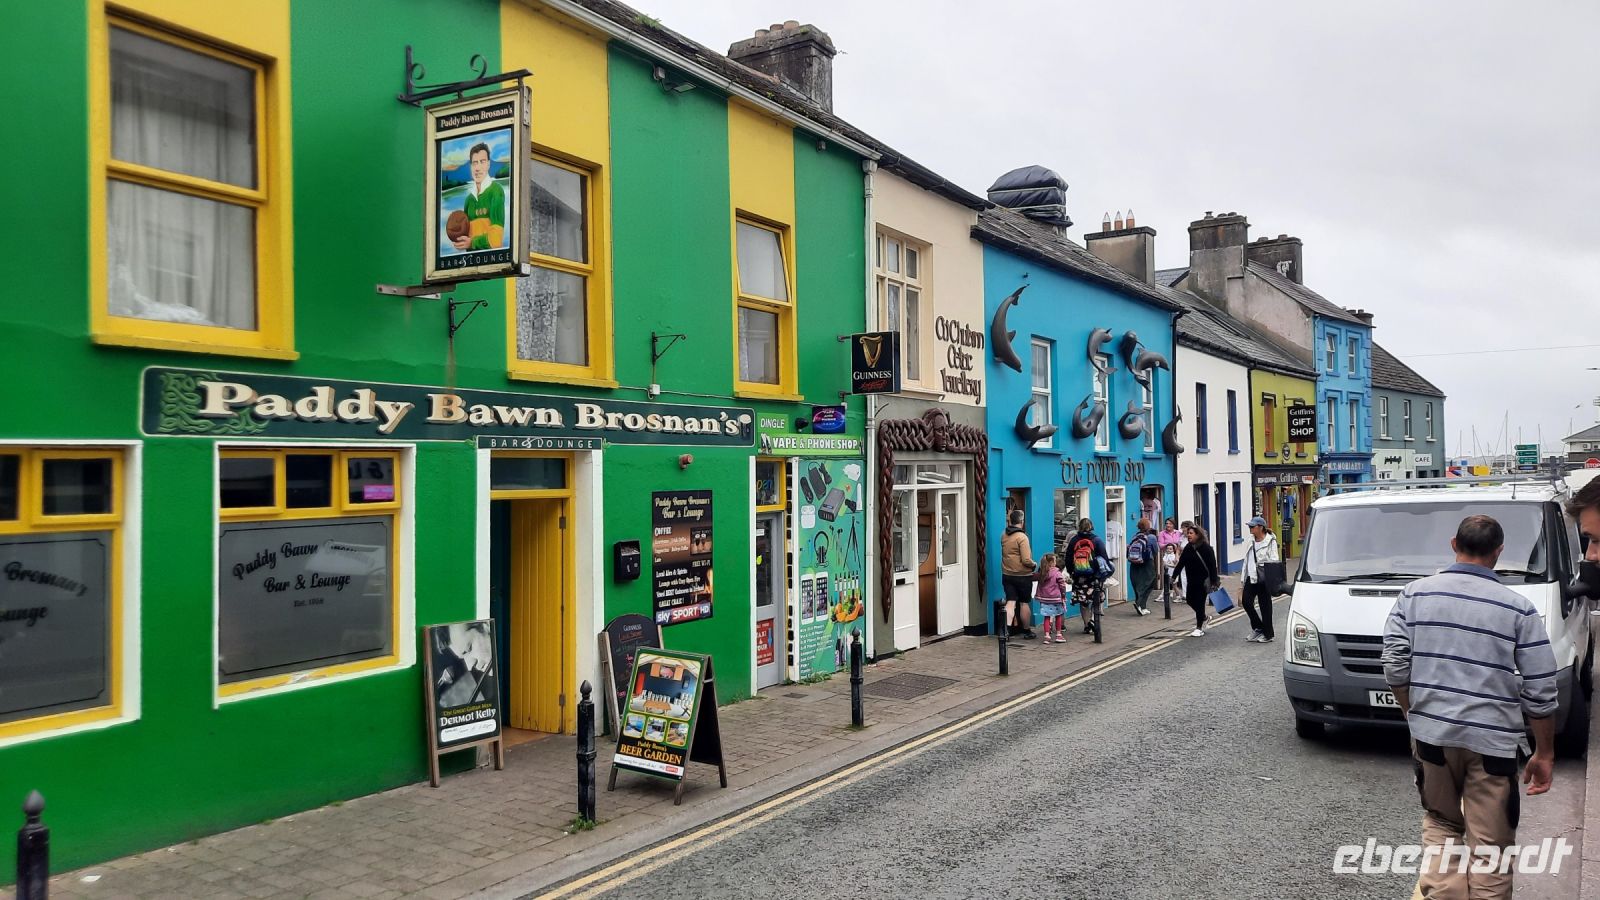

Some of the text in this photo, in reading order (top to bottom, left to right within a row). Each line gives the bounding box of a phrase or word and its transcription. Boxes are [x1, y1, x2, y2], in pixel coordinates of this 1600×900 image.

[440, 105, 513, 128] Paddy Bawn Brosnan's
[441, 260, 458, 268] BAR
[469, 252, 510, 265] LOUNGE
[853, 371, 892, 380] GUINNESS
[199, 381, 740, 436] Paddy Bawn Brosnan's
[1289, 408, 1315, 416] Griffin's
[760, 418, 785, 428] DINGLE
[1292, 418, 1311, 426] GIFT
[1290, 428, 1314, 436] SHOP
[491, 438, 518, 447] BAR
[537, 440, 593, 449] LOUNGE
[773, 437, 858, 449] VAPE & PHONE SHOP
[233, 549, 277, 580] Paddy
[281, 542, 318, 559] Bawn
[264, 573, 351, 593] Bar & Lounge
[657, 605, 710, 623] sky SPORT HD
[619, 743, 643, 757] BEER
[643, 749, 683, 765] GARDEN
